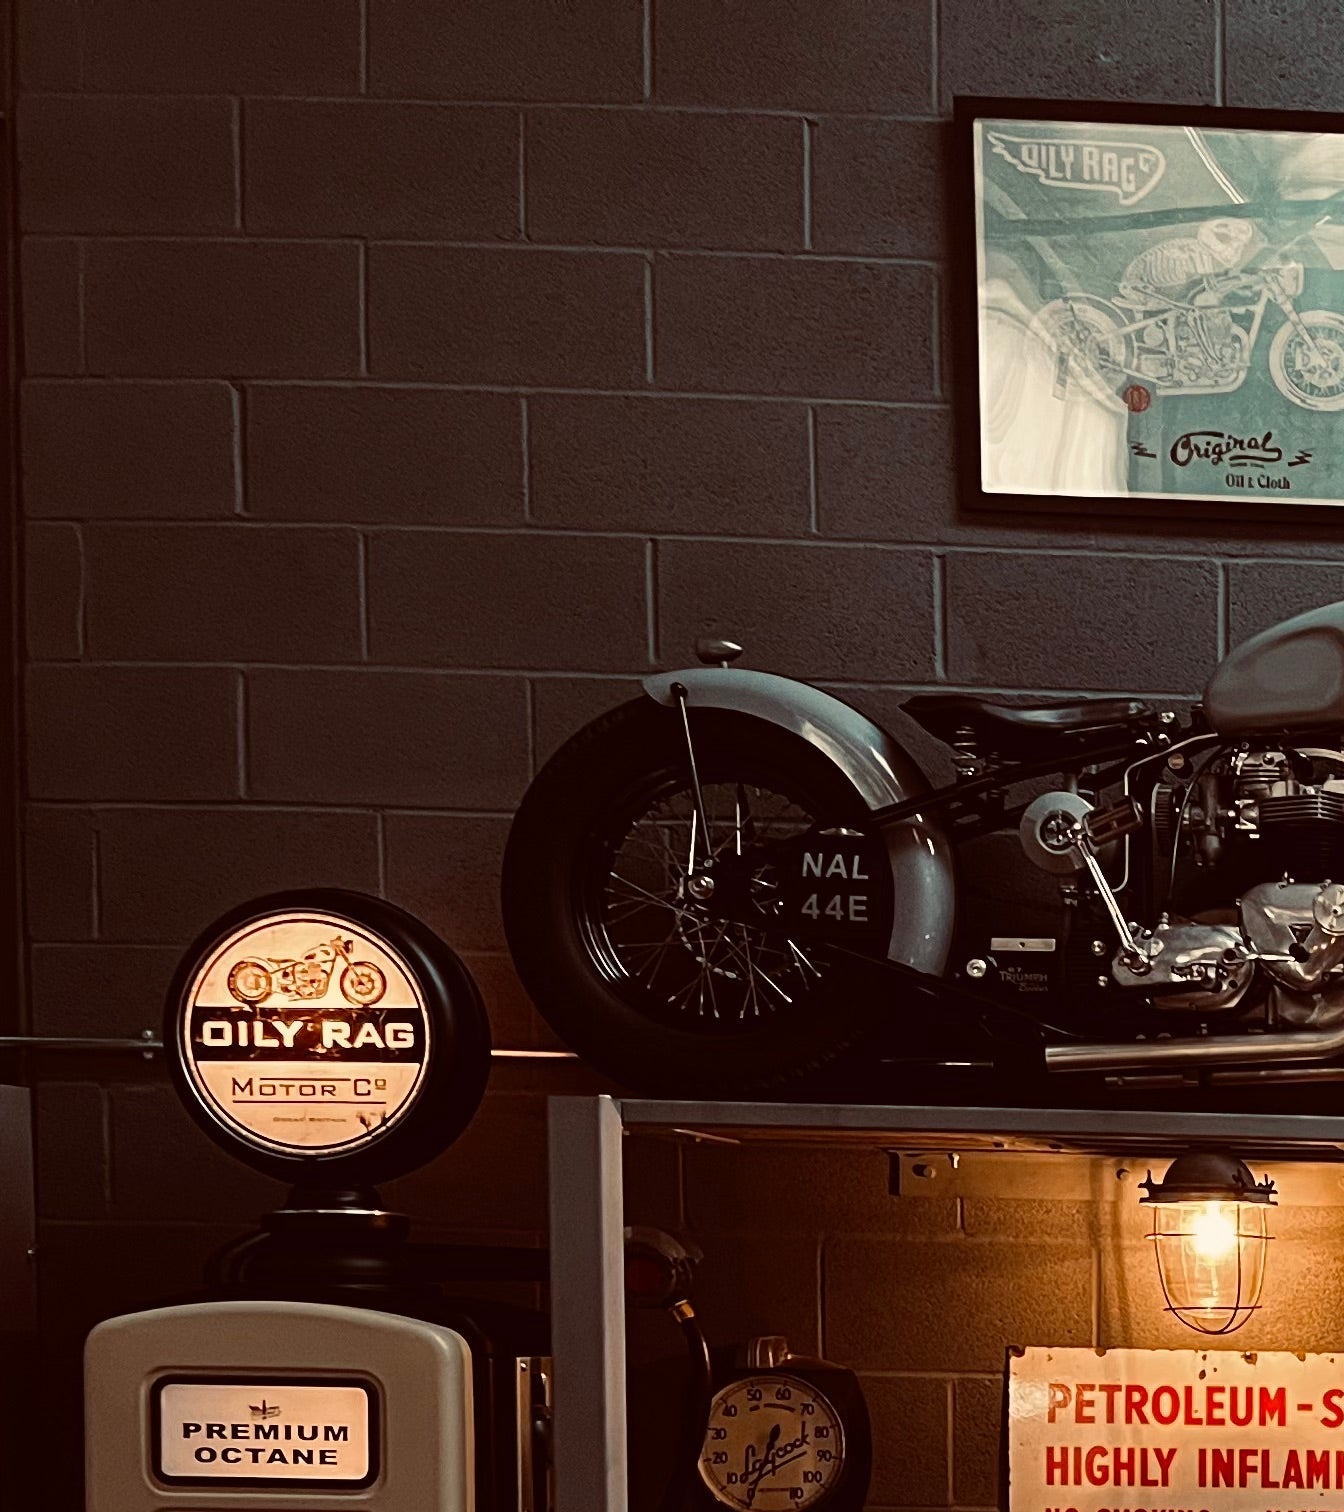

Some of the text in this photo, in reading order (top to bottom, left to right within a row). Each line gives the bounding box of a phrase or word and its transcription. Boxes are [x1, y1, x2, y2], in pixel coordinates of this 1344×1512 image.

[1171, 431, 1283, 467] Original
[802, 852, 869, 880] NAL
[801, 893, 868, 921] 44E
[202, 1020, 414, 1049] OILY RAG
[231, 1077, 336, 1096] MOTOR
[746, 1388, 762, 1401] 50
[775, 1388, 791, 1401] 60
[722, 1405, 737, 1418] 40
[800, 1403, 815, 1417] 70
[182, 1422, 350, 1442] PREMIUM
[711, 1427, 727, 1440] 30
[814, 1425, 829, 1439] 80
[194, 1447, 338, 1466] OCTANE
[711, 1451, 728, 1465] 20
[816, 1449, 832, 1462] 90
[1045, 1446, 1178, 1488] HIGHLY
[802, 1470, 823, 1484] 100
